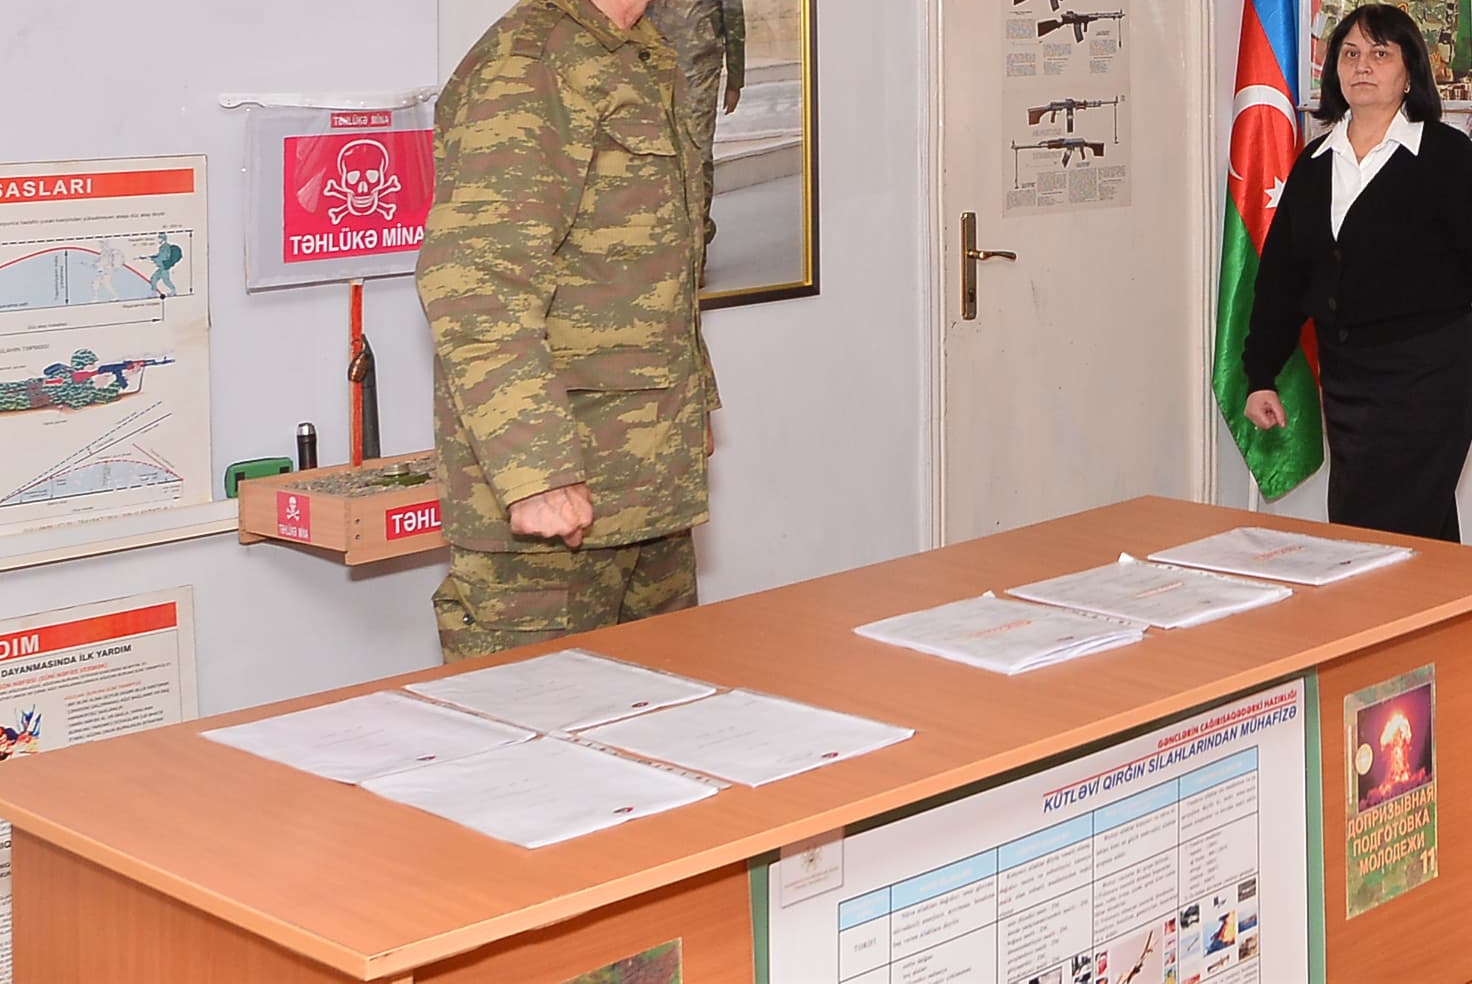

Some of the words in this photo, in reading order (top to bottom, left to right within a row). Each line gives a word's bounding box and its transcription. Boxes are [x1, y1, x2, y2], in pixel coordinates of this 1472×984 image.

[0, 178, 92, 199] ASLARI
[289, 227, 378, 255] TƏHLÜKƏ
[382, 223, 424, 247] MİNA
[392, 507, 442, 534] TƏHL
[1043, 777, 1100, 813] KÜTLƏVİ
[1103, 761, 1145, 791] QIRĞIN
[1148, 727, 1238, 773] SİLAHLARINDAN
[1240, 705, 1297, 736] MÜHAFİZƏ
[1348, 784, 1434, 840] ДОПРИЗЫВНАЯ
[1353, 808, 1430, 857] ПОДГОТОВКА
[1359, 832, 1425, 876] МОЛОДЕЖИ
[1420, 848, 1436, 875] 11
